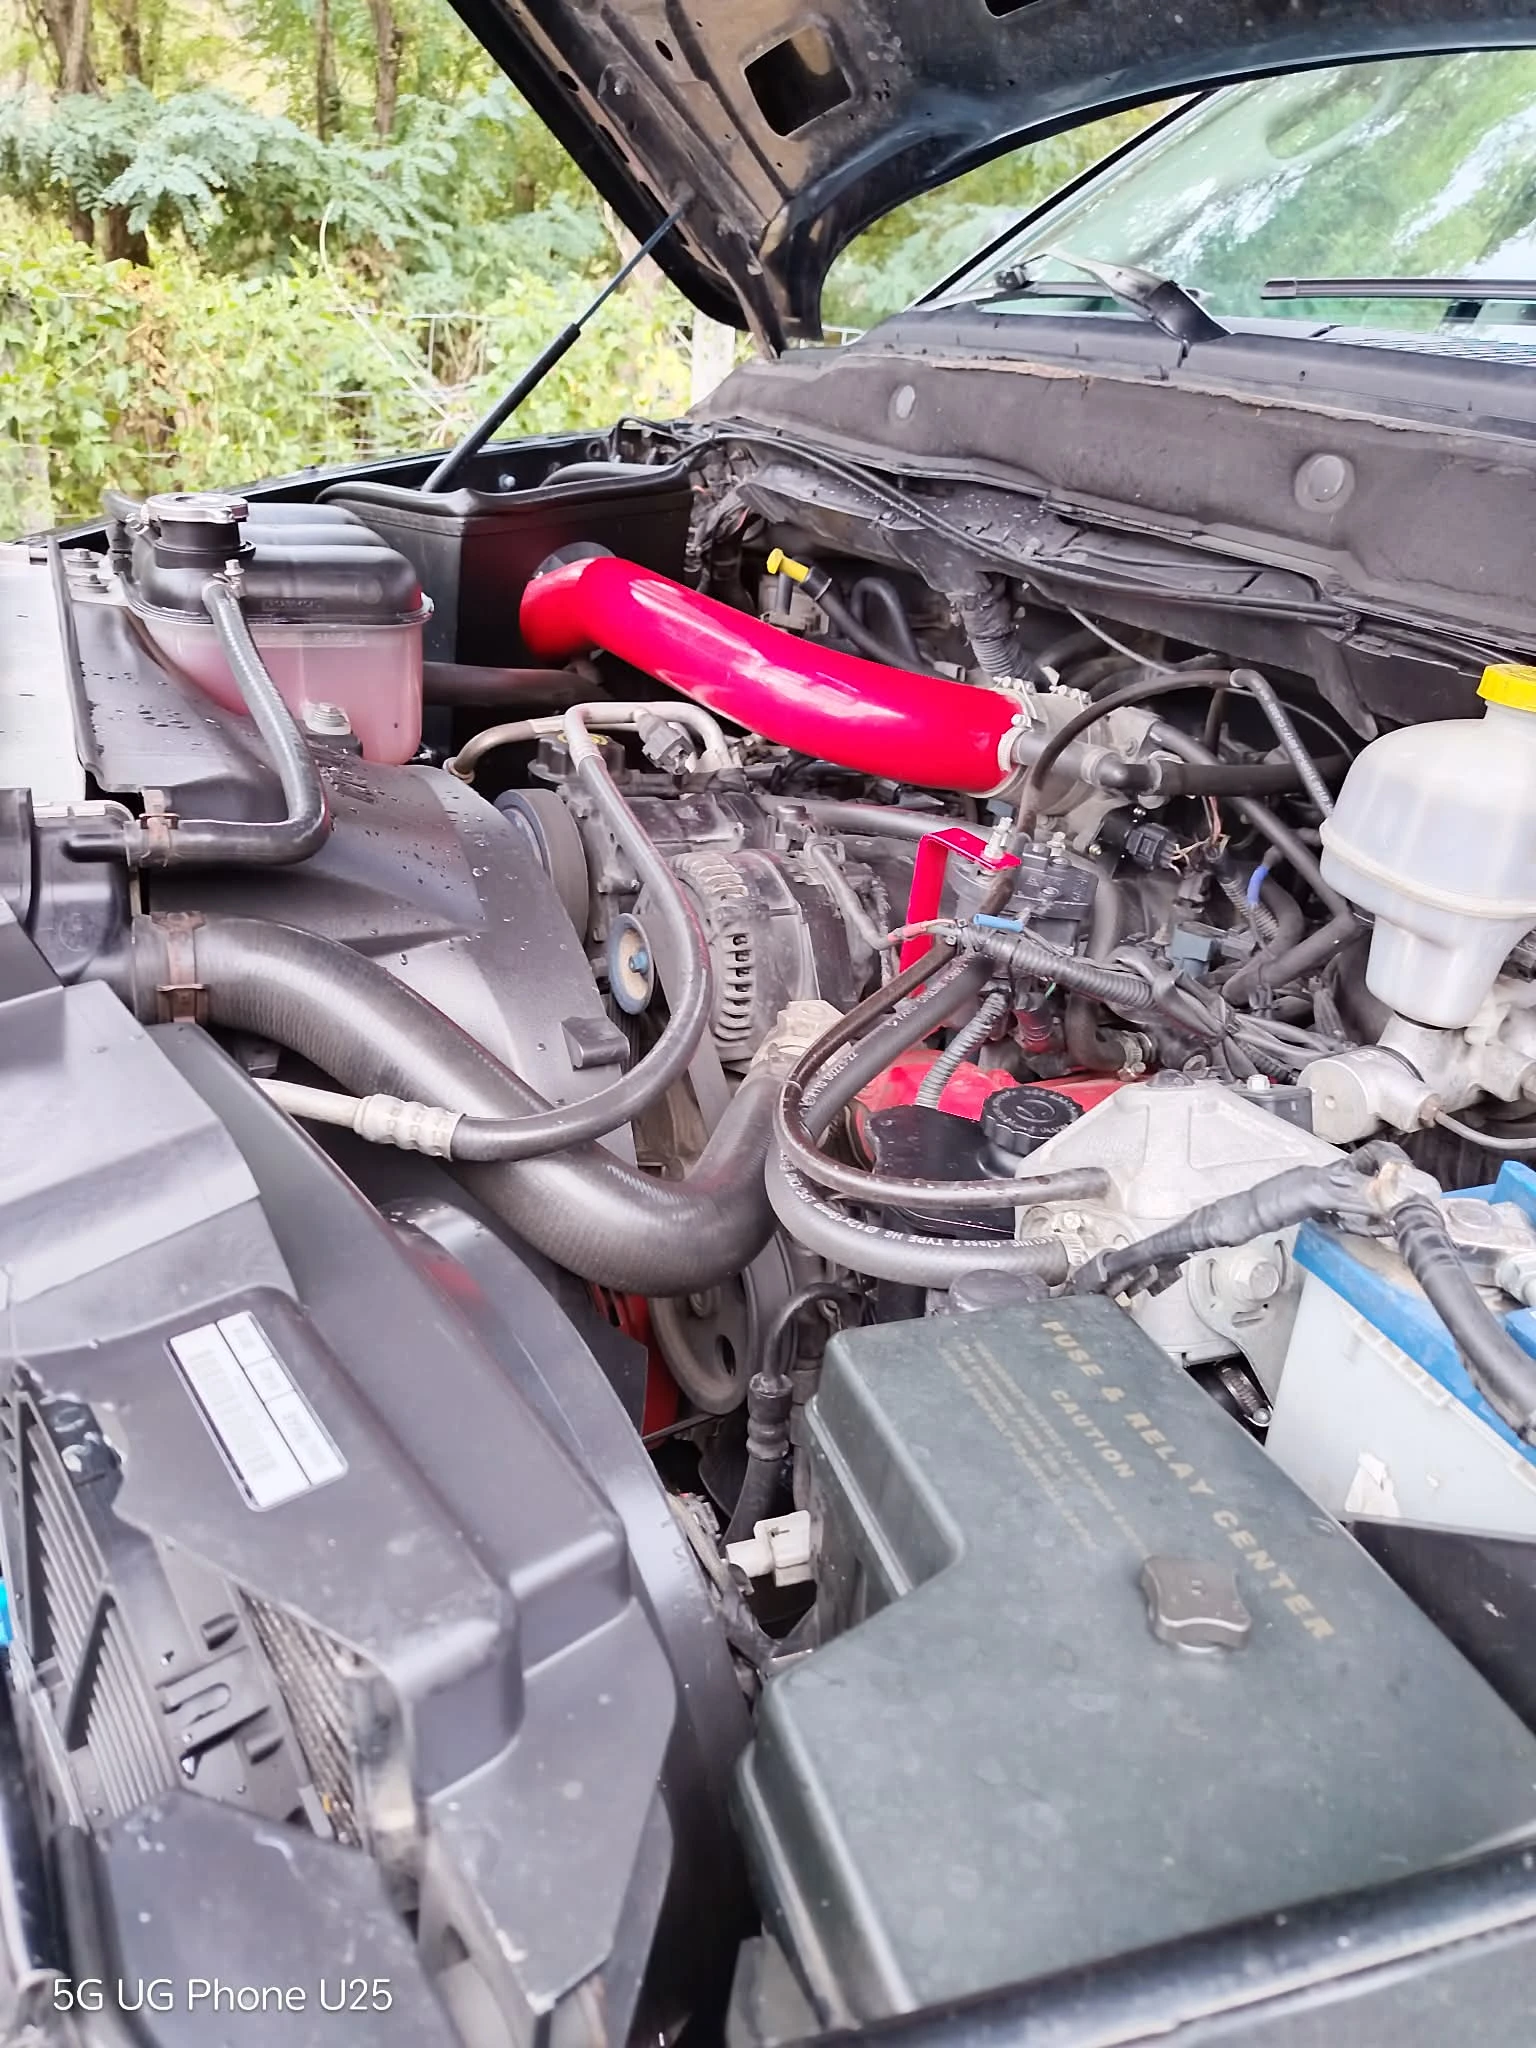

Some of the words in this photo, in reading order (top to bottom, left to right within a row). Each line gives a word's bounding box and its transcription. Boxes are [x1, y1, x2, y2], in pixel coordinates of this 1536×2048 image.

[907, 1234, 945, 1246] TYPE
[951, 1239, 960, 1247] 2
[962, 1239, 1000, 1248] Class
[1050, 1390, 1136, 1478] CAUTION
[1042, 1320, 1104, 1378] FUSE
[1101, 1385, 1127, 1403] &
[1124, 1412, 1215, 1497] RELAY
[1212, 1510, 1335, 1640] CENTER
